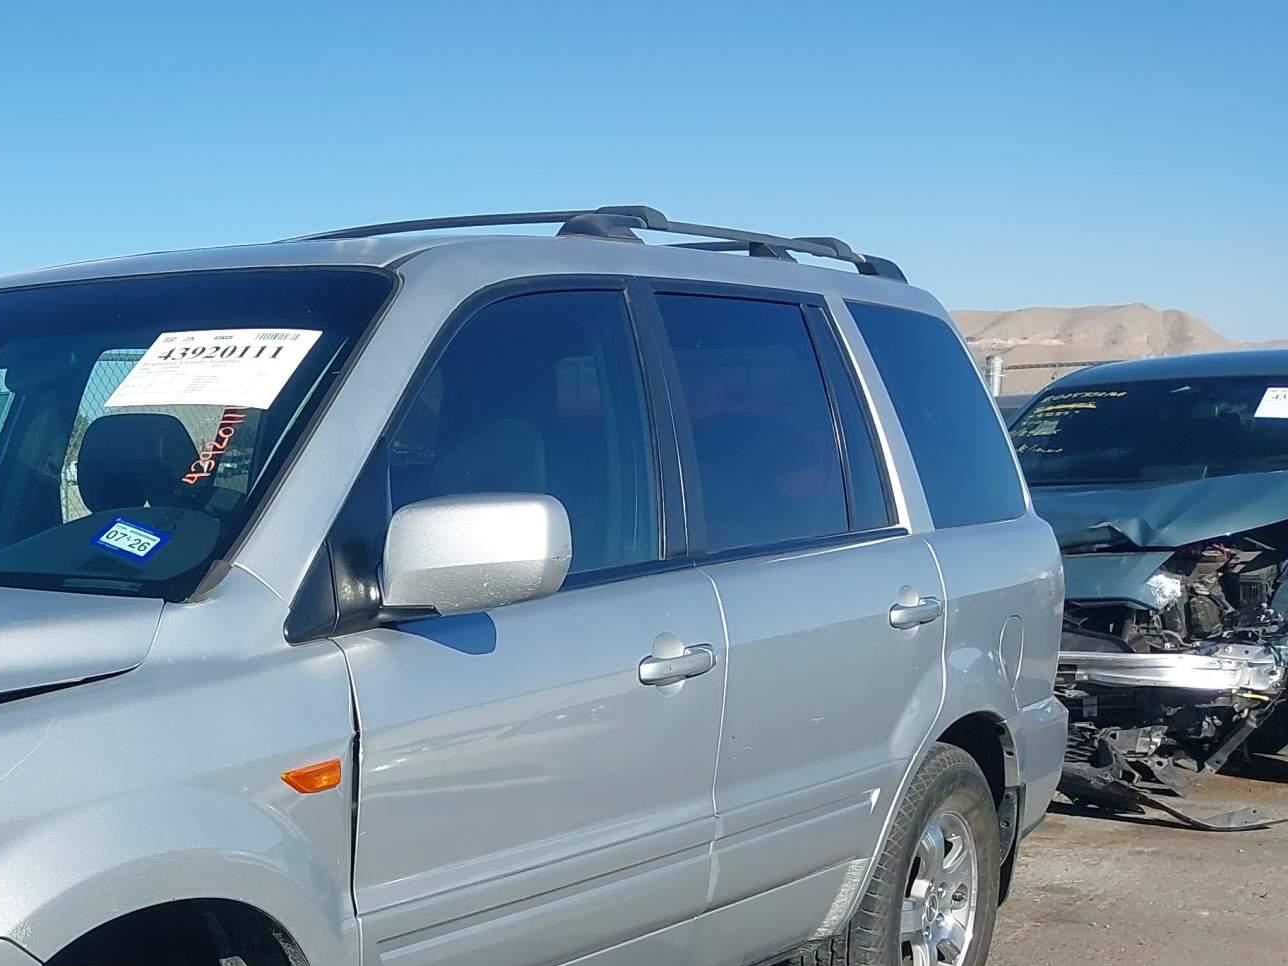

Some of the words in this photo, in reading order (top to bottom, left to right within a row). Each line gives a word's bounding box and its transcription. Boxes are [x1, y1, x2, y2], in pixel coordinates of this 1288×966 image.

[158, 345, 285, 361] 43920111
[105, 529, 128, 542] 07
[127, 538, 151, 552] 26
